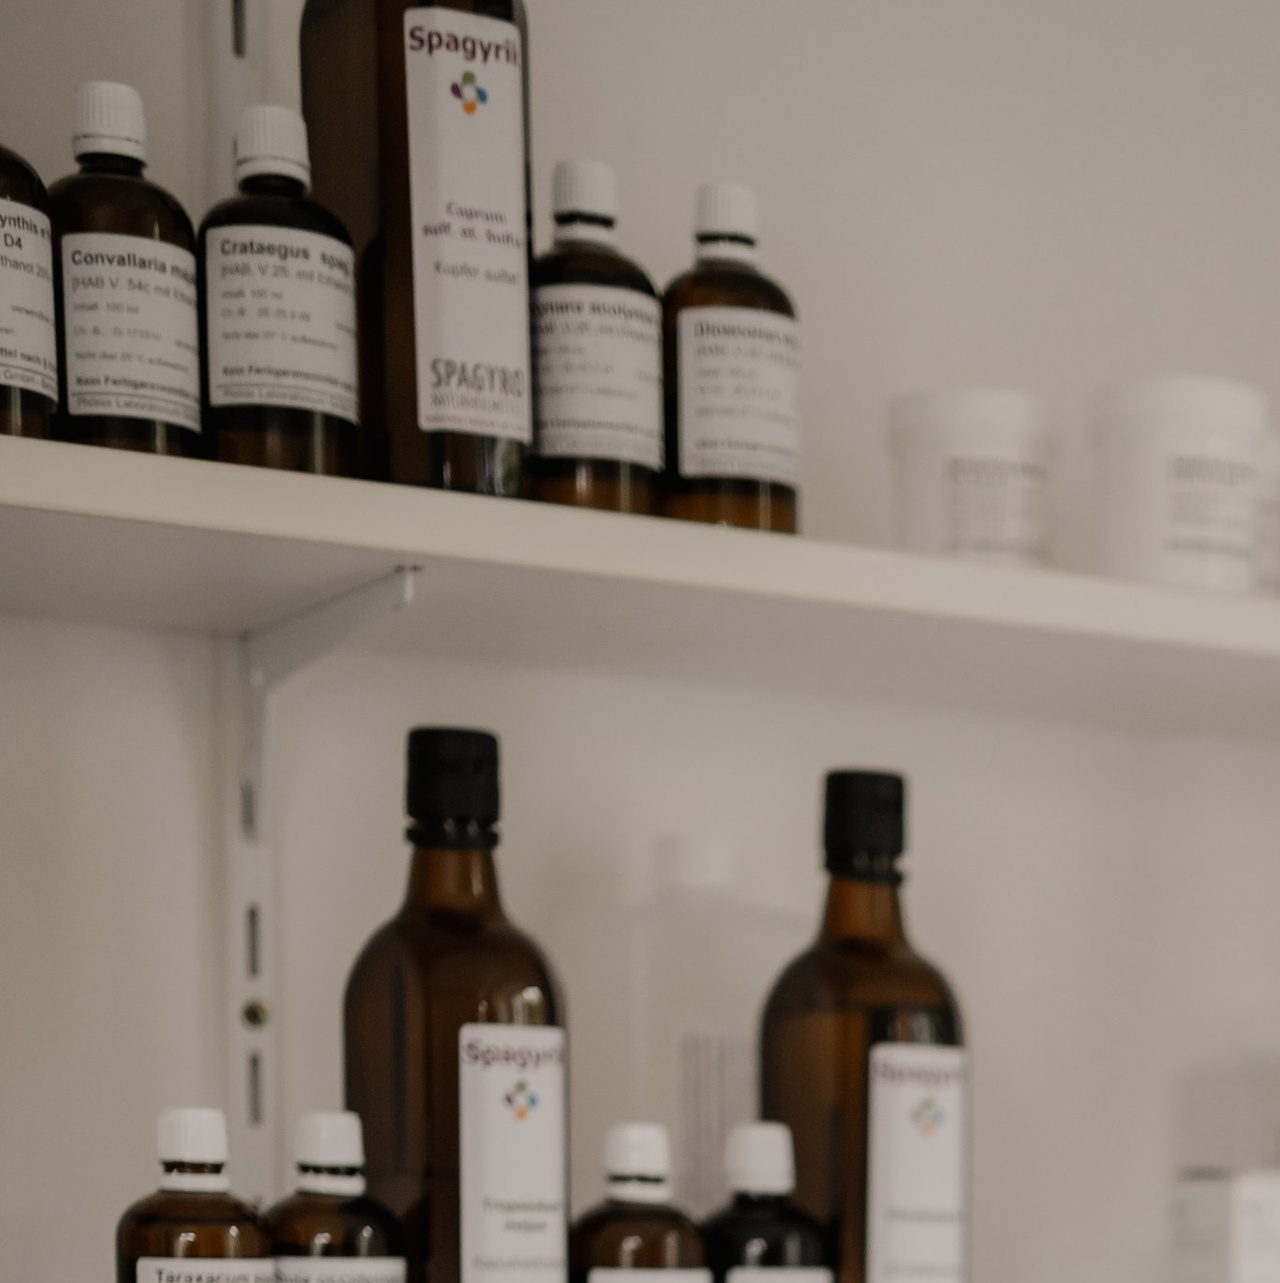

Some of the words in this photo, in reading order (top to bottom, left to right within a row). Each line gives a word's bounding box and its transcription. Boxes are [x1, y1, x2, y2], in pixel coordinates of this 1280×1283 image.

[408, 26, 520, 65] Spagyri
[4, 233, 22, 250] D4
[220, 239, 310, 261] Crataegus
[71, 249, 167, 274] Convallaria
